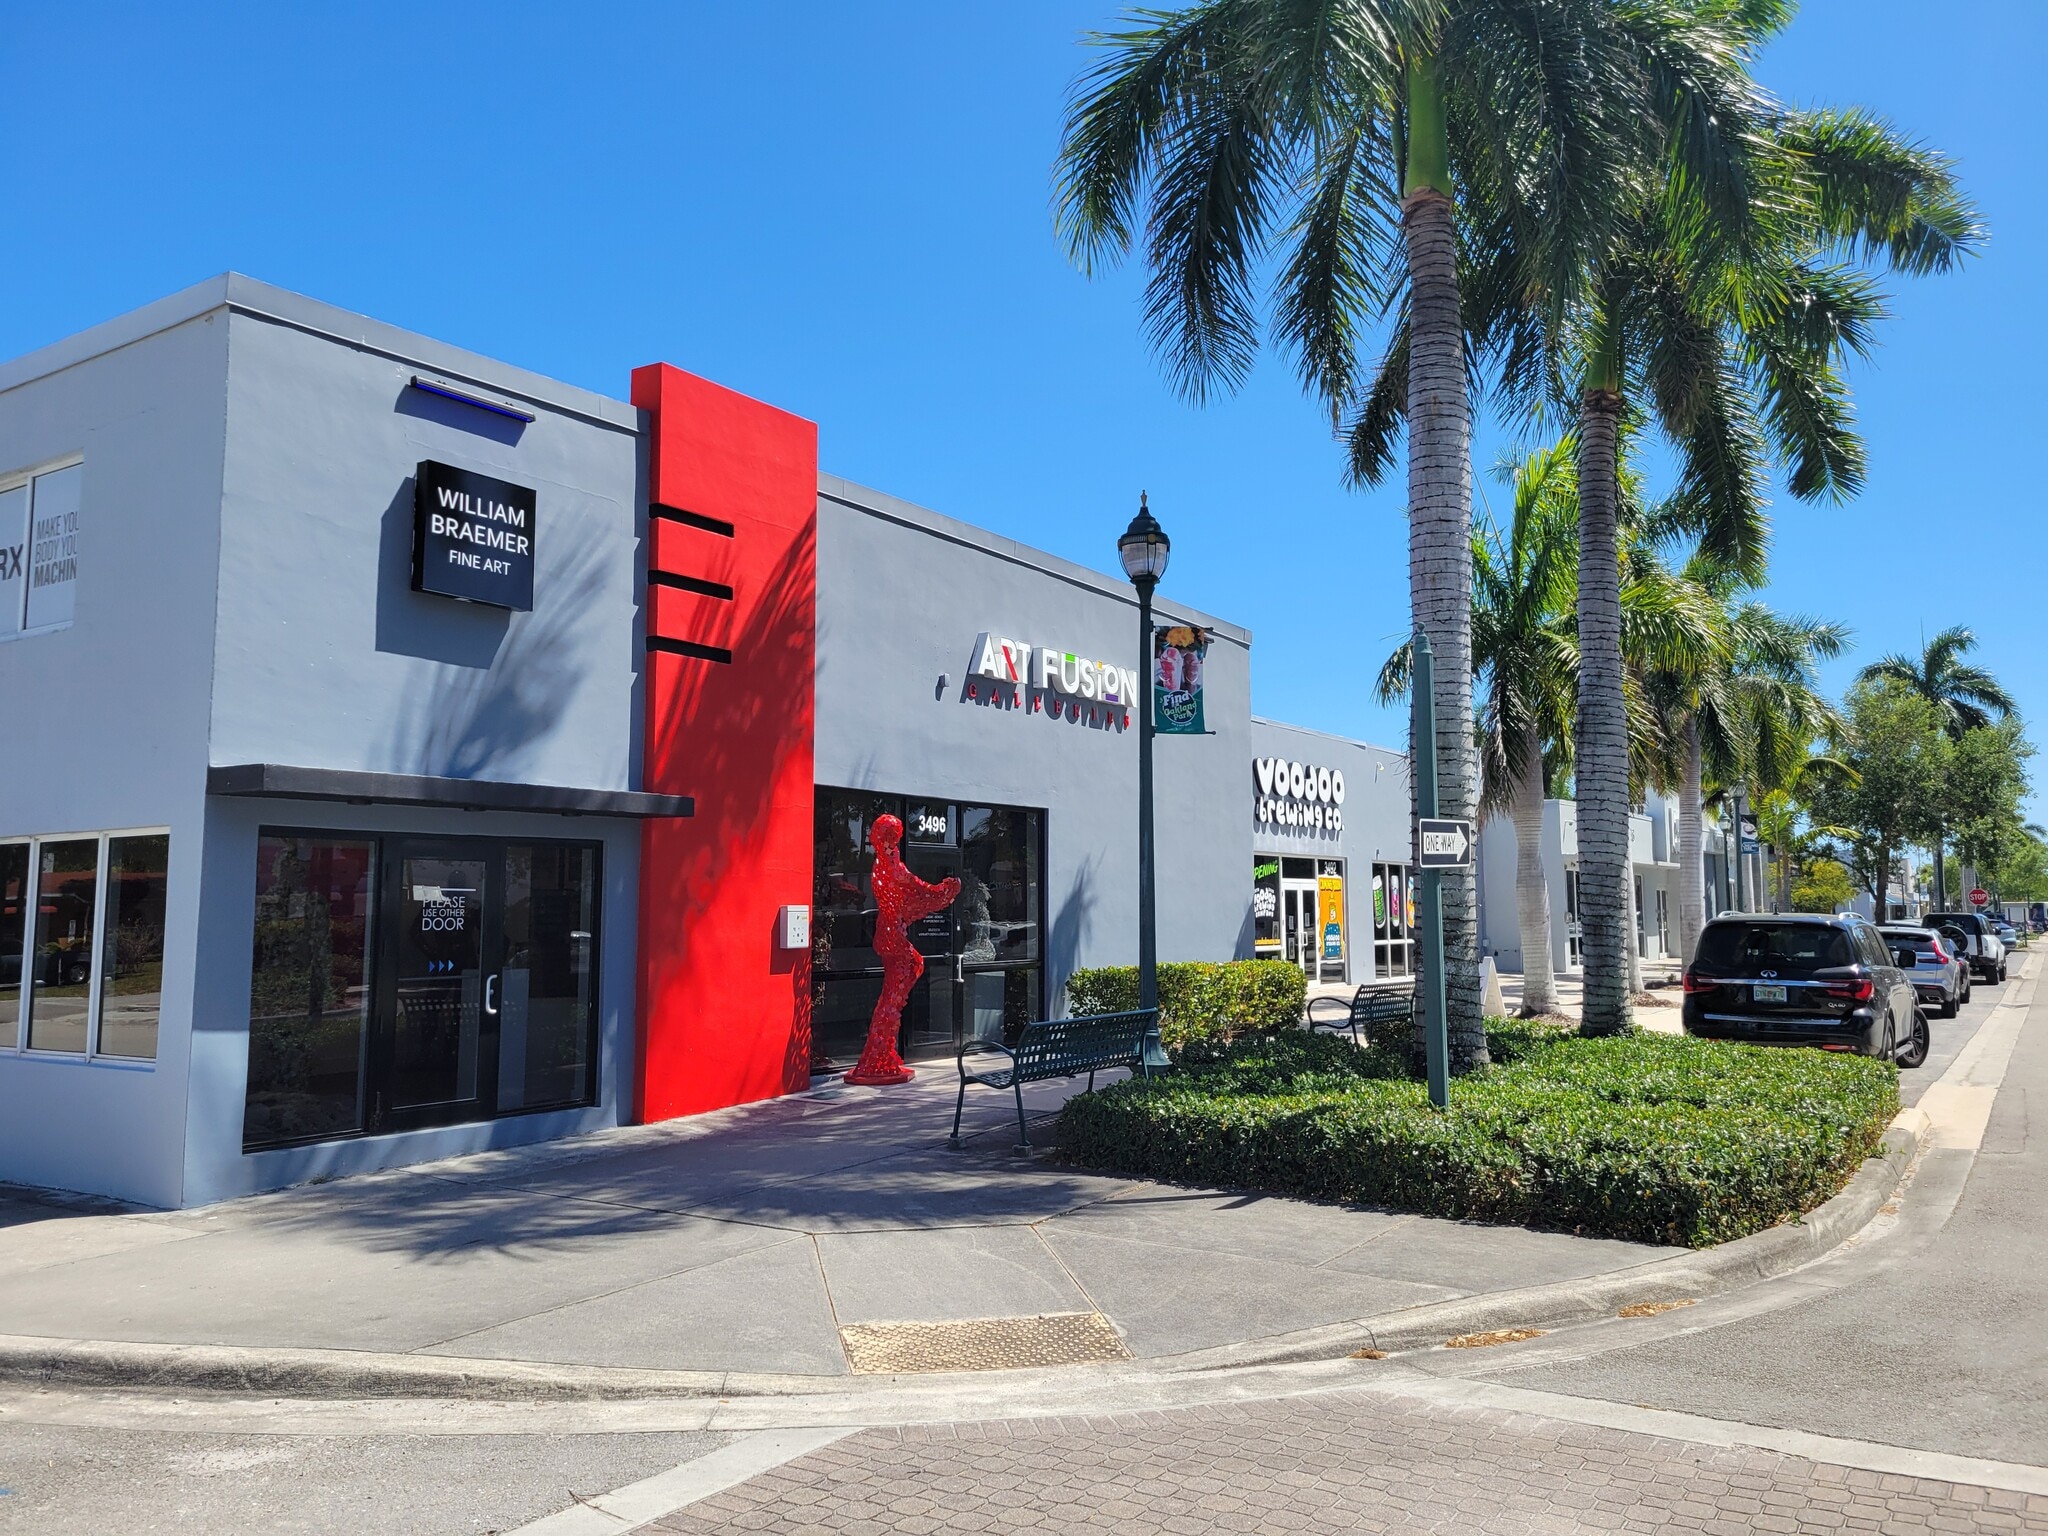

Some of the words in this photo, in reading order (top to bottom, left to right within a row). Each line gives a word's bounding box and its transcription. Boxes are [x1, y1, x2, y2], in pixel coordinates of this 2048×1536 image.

[438, 486, 526, 528] WILLIAM
[37, 515, 61, 541] MAKE
[431, 513, 529, 556] BRAEMER
[35, 537, 59, 564] BODY
[449, 549, 481, 570] FINE
[482, 557, 512, 576] ART
[969, 632, 1030, 684] ART
[1163, 690, 1190, 707] Find
[1163, 701, 1197, 716] Oakland
[1173, 711, 1192, 720] Park
[918, 815, 946, 833] 3496
[1425, 834, 1439, 851] ONE
[1441, 834, 1456, 851] WAY
[423, 896, 465, 908] PLEASE
[1970, 893, 1987, 901] STOP
[423, 908, 437, 917] USE
[439, 908, 465, 917] OTHER
[422, 917, 464, 931] DOOR
